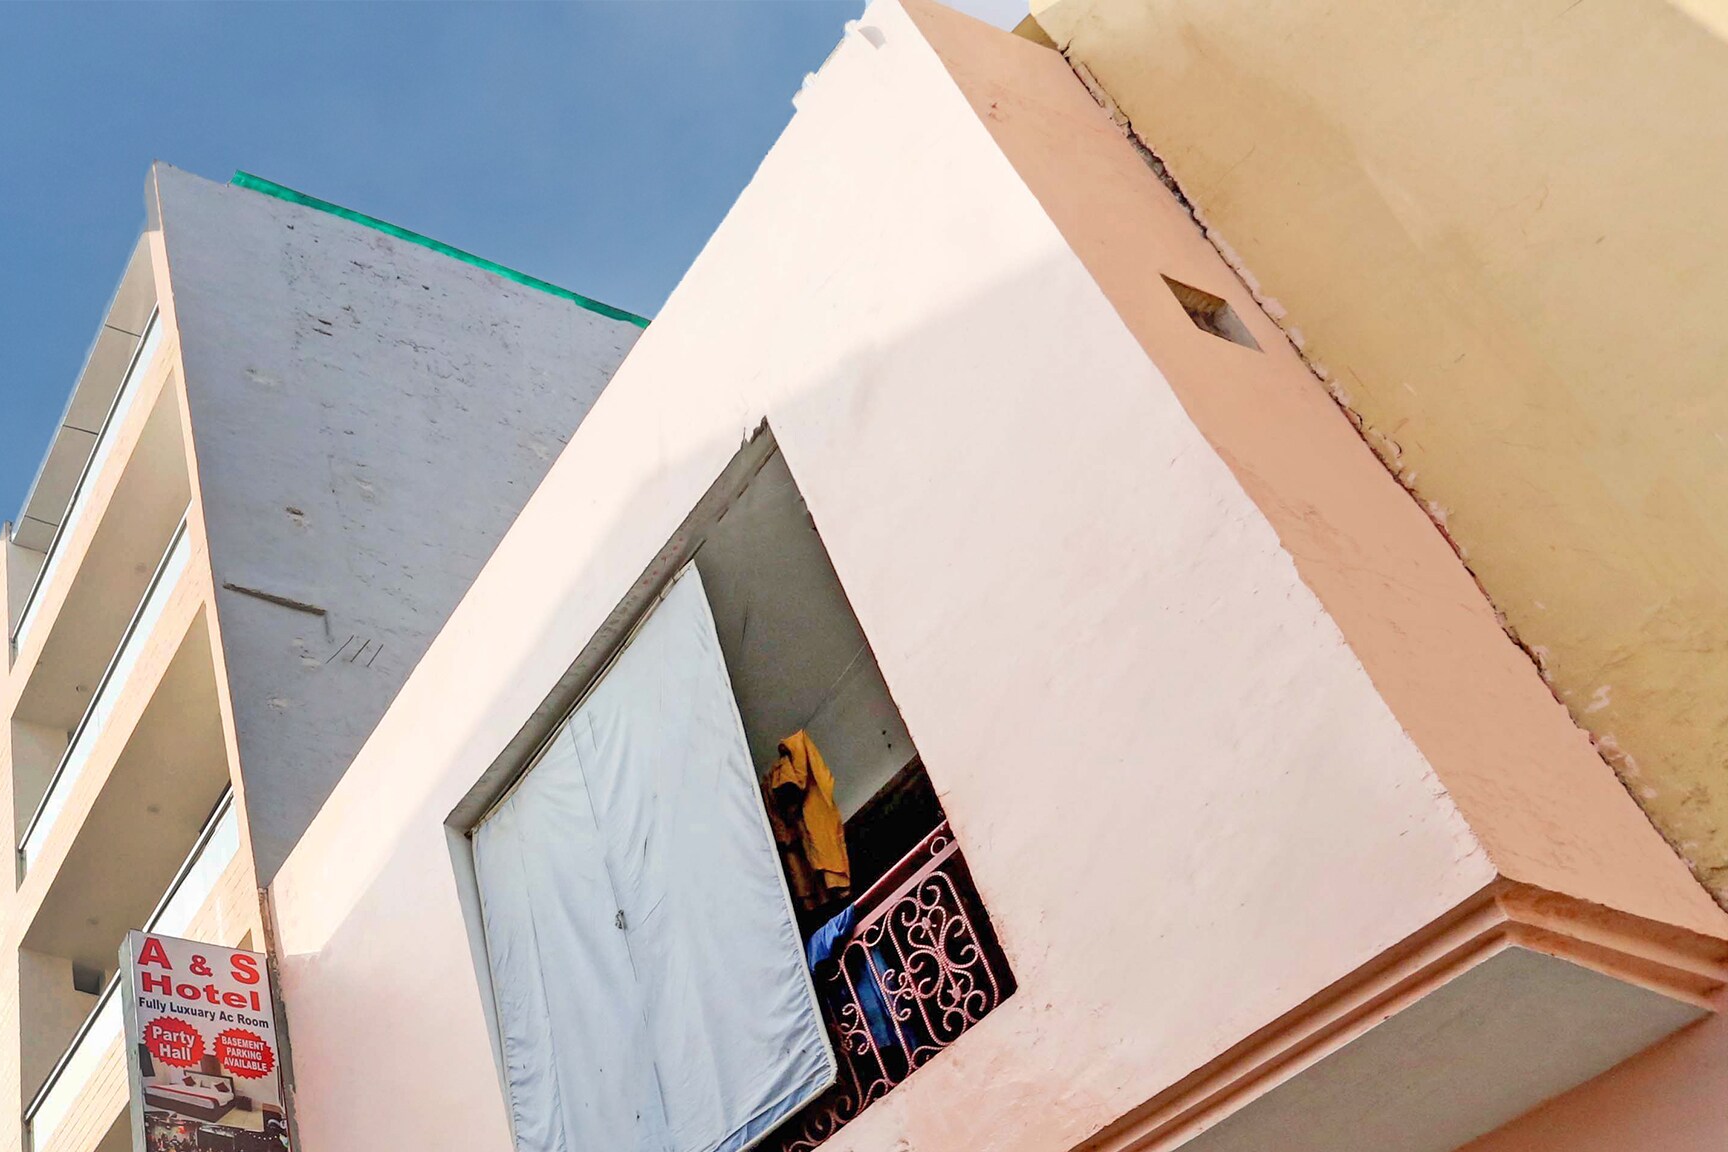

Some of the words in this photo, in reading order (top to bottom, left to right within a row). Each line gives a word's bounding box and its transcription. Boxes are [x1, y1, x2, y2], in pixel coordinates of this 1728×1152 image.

[138, 937, 173, 970] A
[189, 954, 213, 977] &
[230, 953, 260, 985] S
[141, 972, 261, 1011] Hotel
[139, 997, 166, 1013] Fully
[170, 1002, 216, 1021] Luxuary
[219, 1011, 233, 1023] Ac
[237, 1014, 269, 1029] Room
[152, 1026, 195, 1048] Party
[221, 1035, 265, 1051] BASEMENT
[159, 1043, 191, 1061] Hall
[226, 1047, 262, 1061] PARKING
[224, 1057, 268, 1072] AVAILABLE
